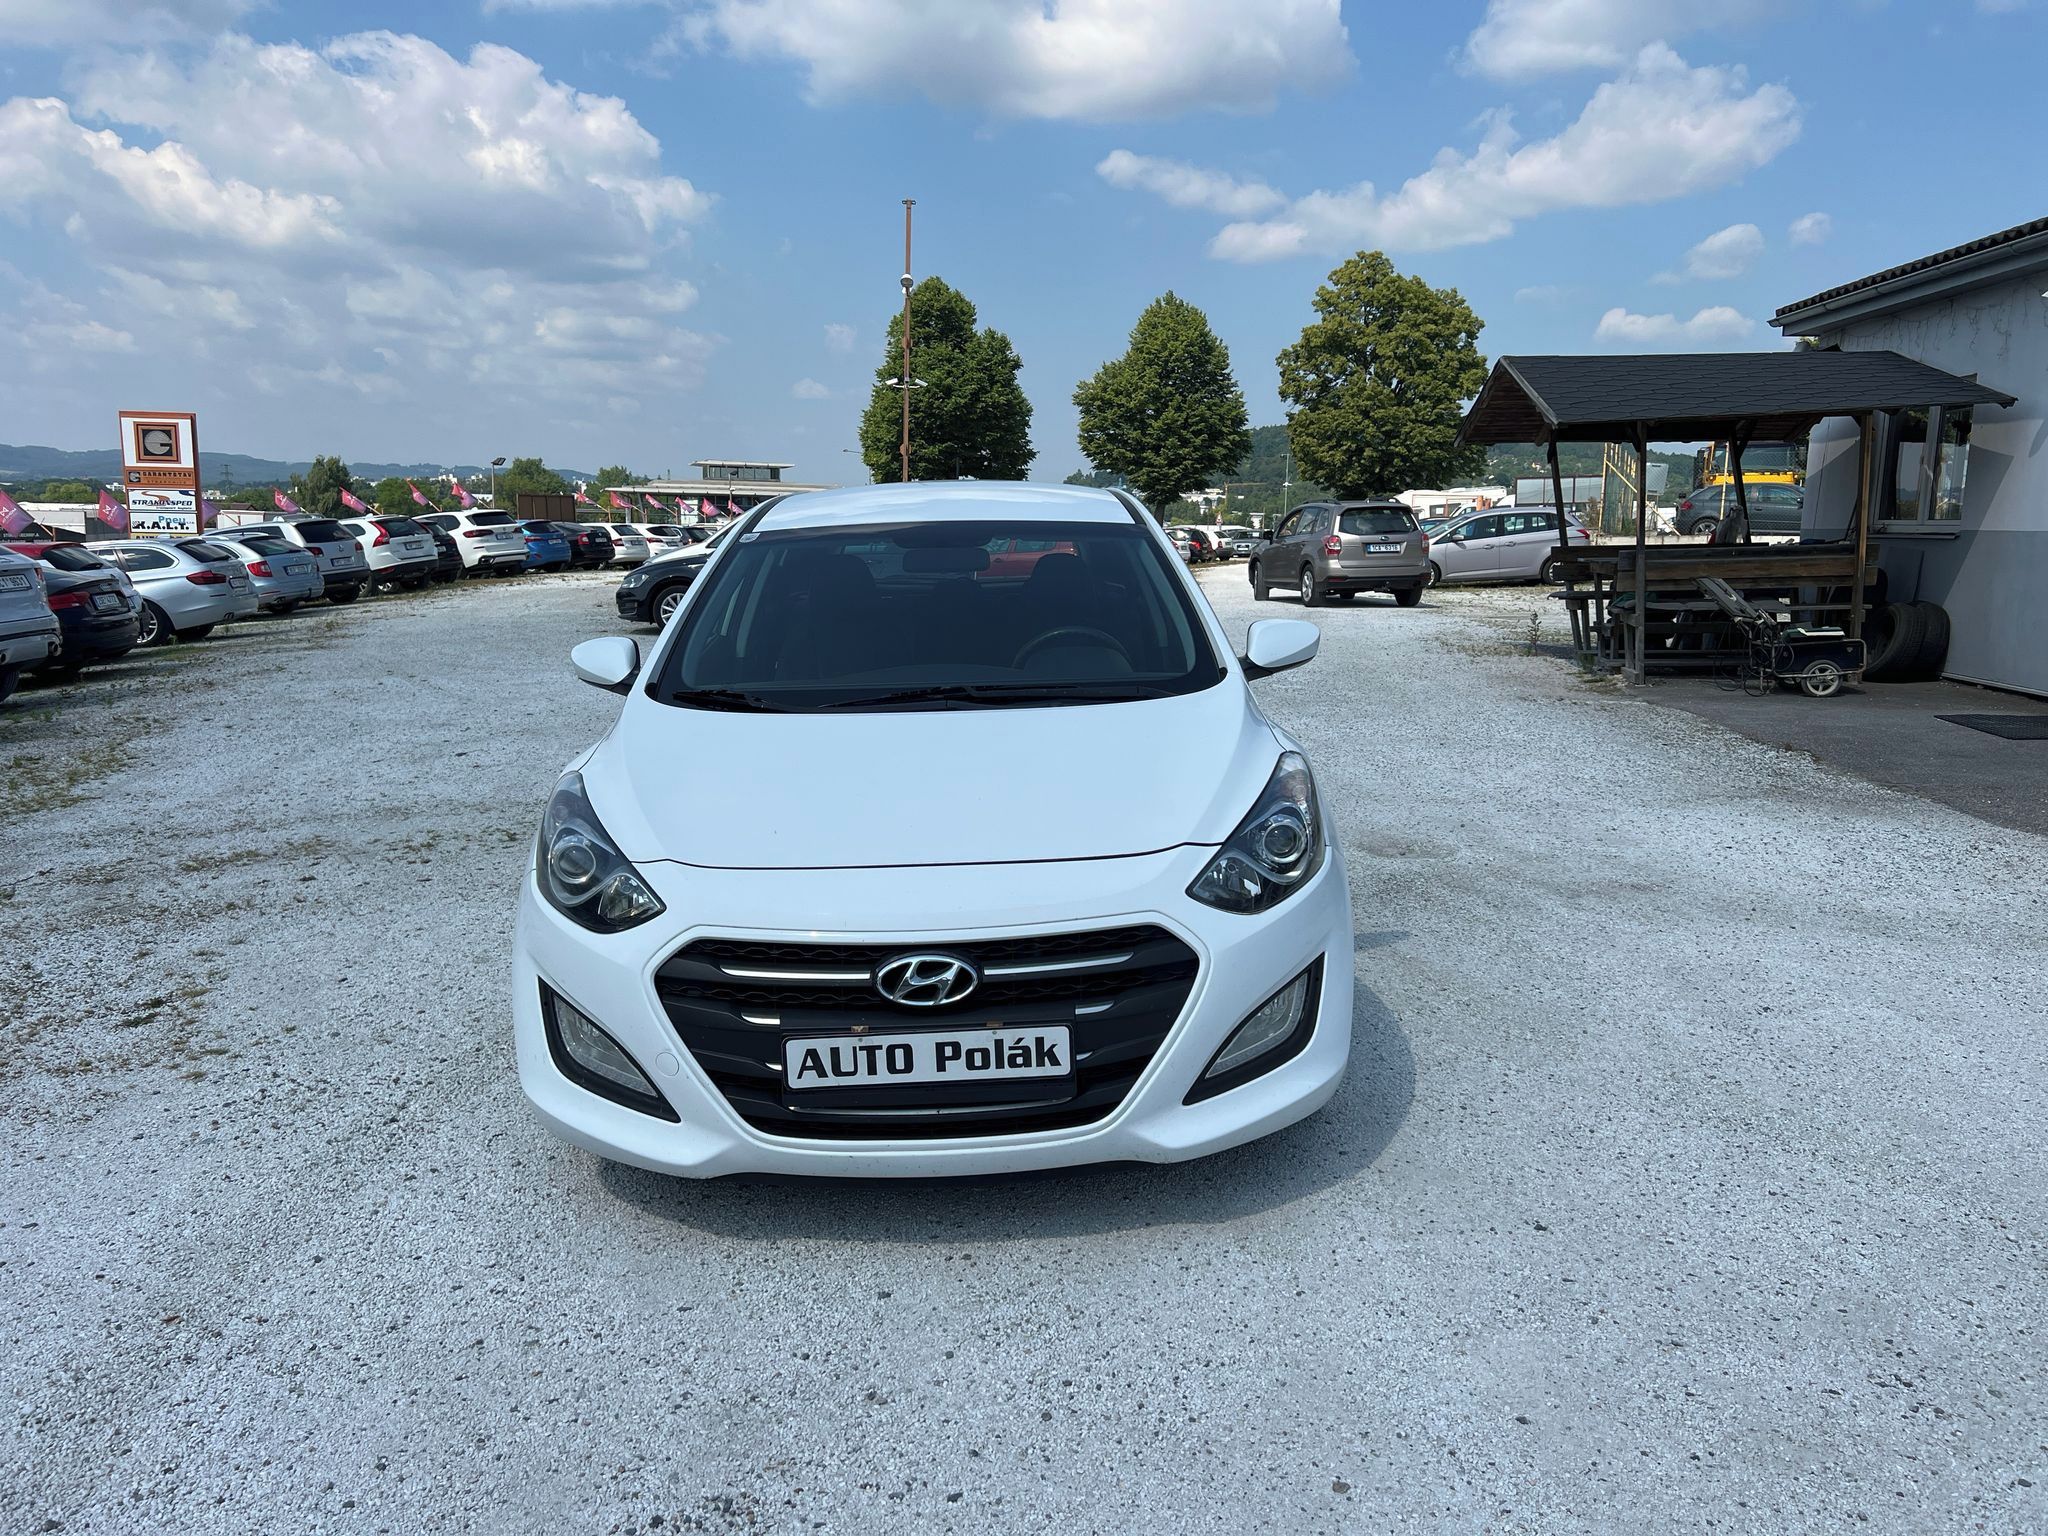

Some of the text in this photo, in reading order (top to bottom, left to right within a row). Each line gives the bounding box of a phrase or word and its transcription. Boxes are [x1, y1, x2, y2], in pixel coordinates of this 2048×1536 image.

[158, 515, 186, 524] Pneu
[796, 1036, 1062, 1080] AUTO Polák
